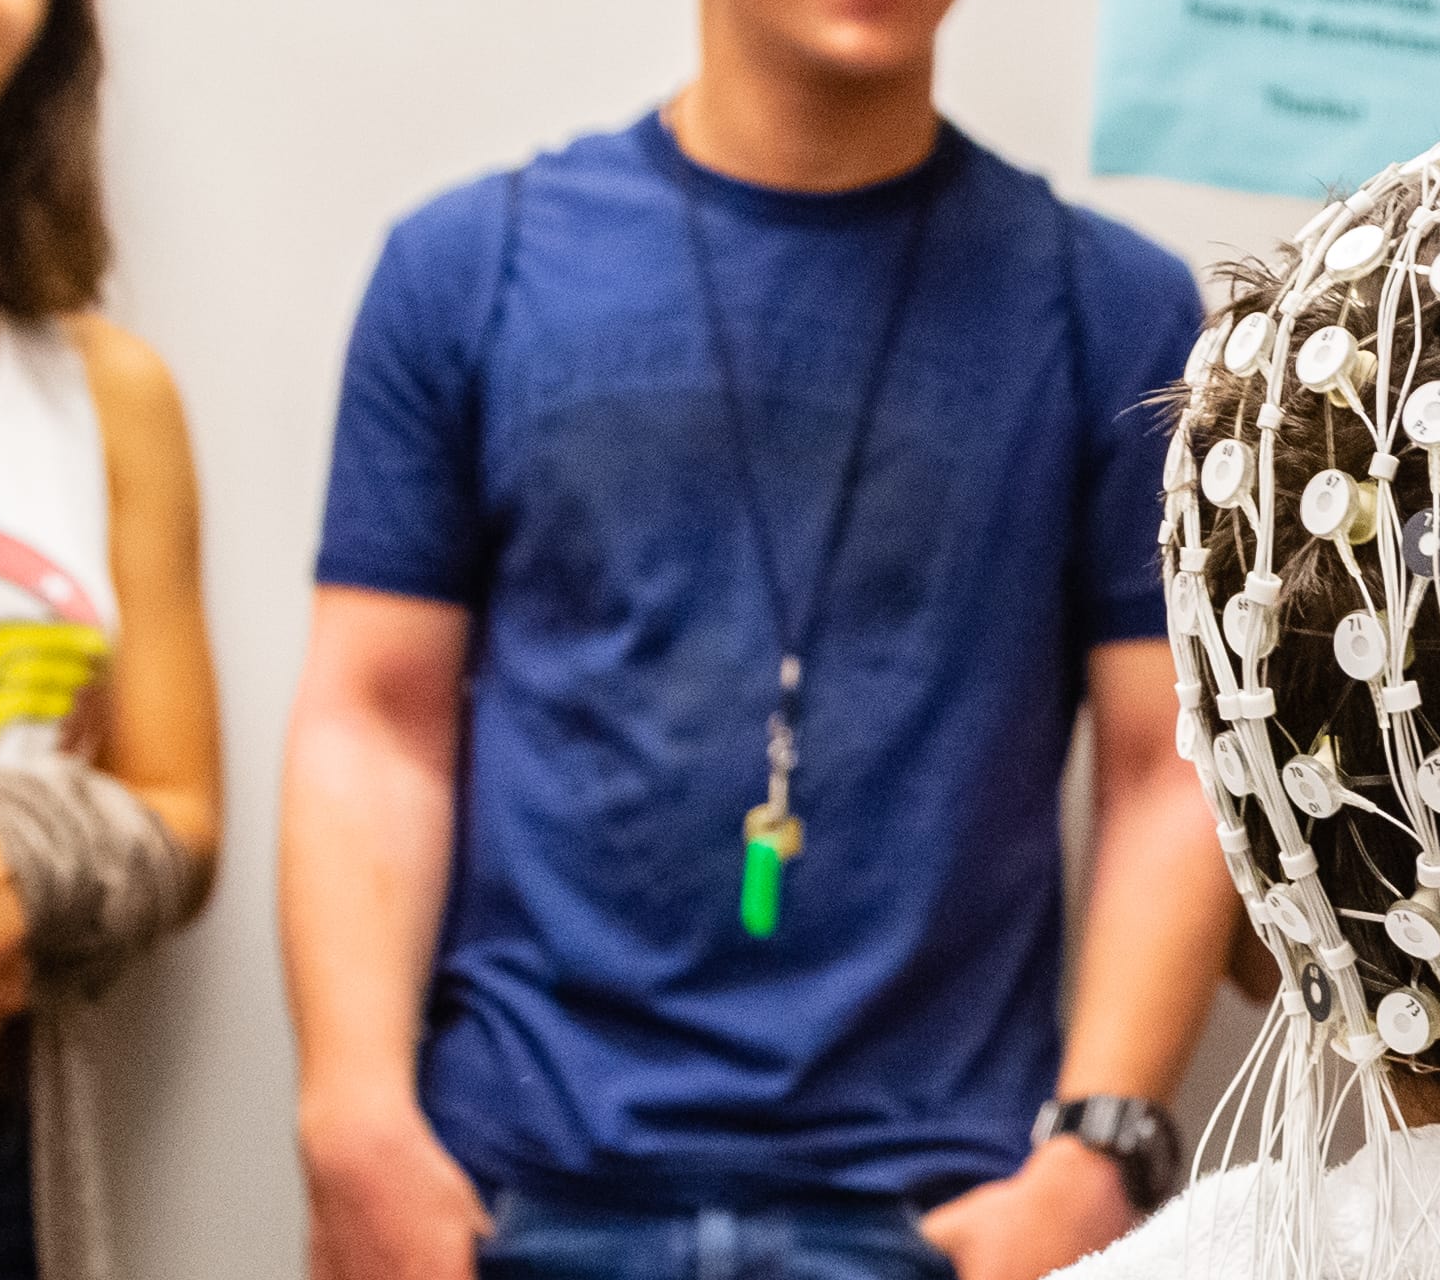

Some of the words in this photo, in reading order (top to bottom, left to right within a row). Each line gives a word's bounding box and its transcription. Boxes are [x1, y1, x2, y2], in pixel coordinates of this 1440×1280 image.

[1326, 477, 1339, 488] 67
[1238, 599, 1249, 610] 66
[1348, 618, 1362, 632] 71
[1291, 767, 1303, 778] 70
[1394, 912, 1411, 923] 74
[1405, 1000, 1421, 1016] 73
